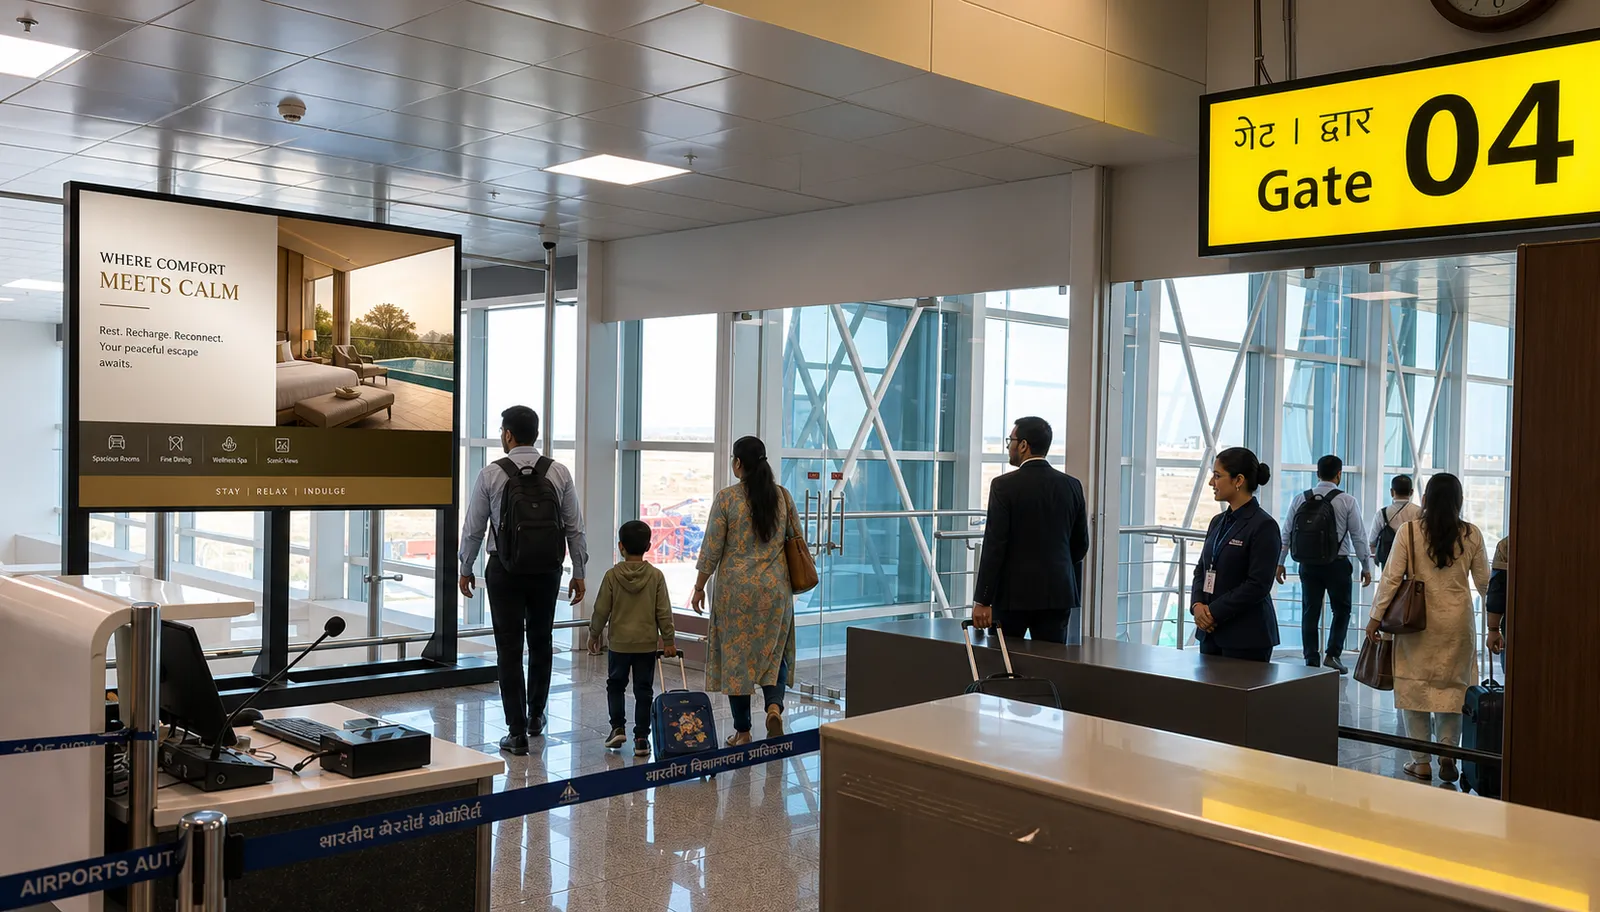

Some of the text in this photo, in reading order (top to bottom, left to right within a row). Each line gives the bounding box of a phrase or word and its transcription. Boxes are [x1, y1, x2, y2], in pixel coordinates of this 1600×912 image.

[1234, 116, 1276, 150] गेट
[1319, 107, 1374, 142] द्वार
[1257, 79, 1574, 212] Gate 04
[100, 252, 226, 275] WHERE COMFORT
[100, 271, 239, 300] MEETS CALM
[99, 326, 223, 343] Rest. Recharge. Reconnect.
[99, 342, 199, 357] Your peaceful escape
[99, 359, 133, 368] awaits.
[237, 456, 248, 465] Spa
[215, 487, 241, 495] STAY
[256, 487, 288, 495] RELAX
[303, 487, 346, 495] INDULGE
[319, 825, 375, 849] भारतीय
[20, 850, 178, 898] AIRPORTS AUT
